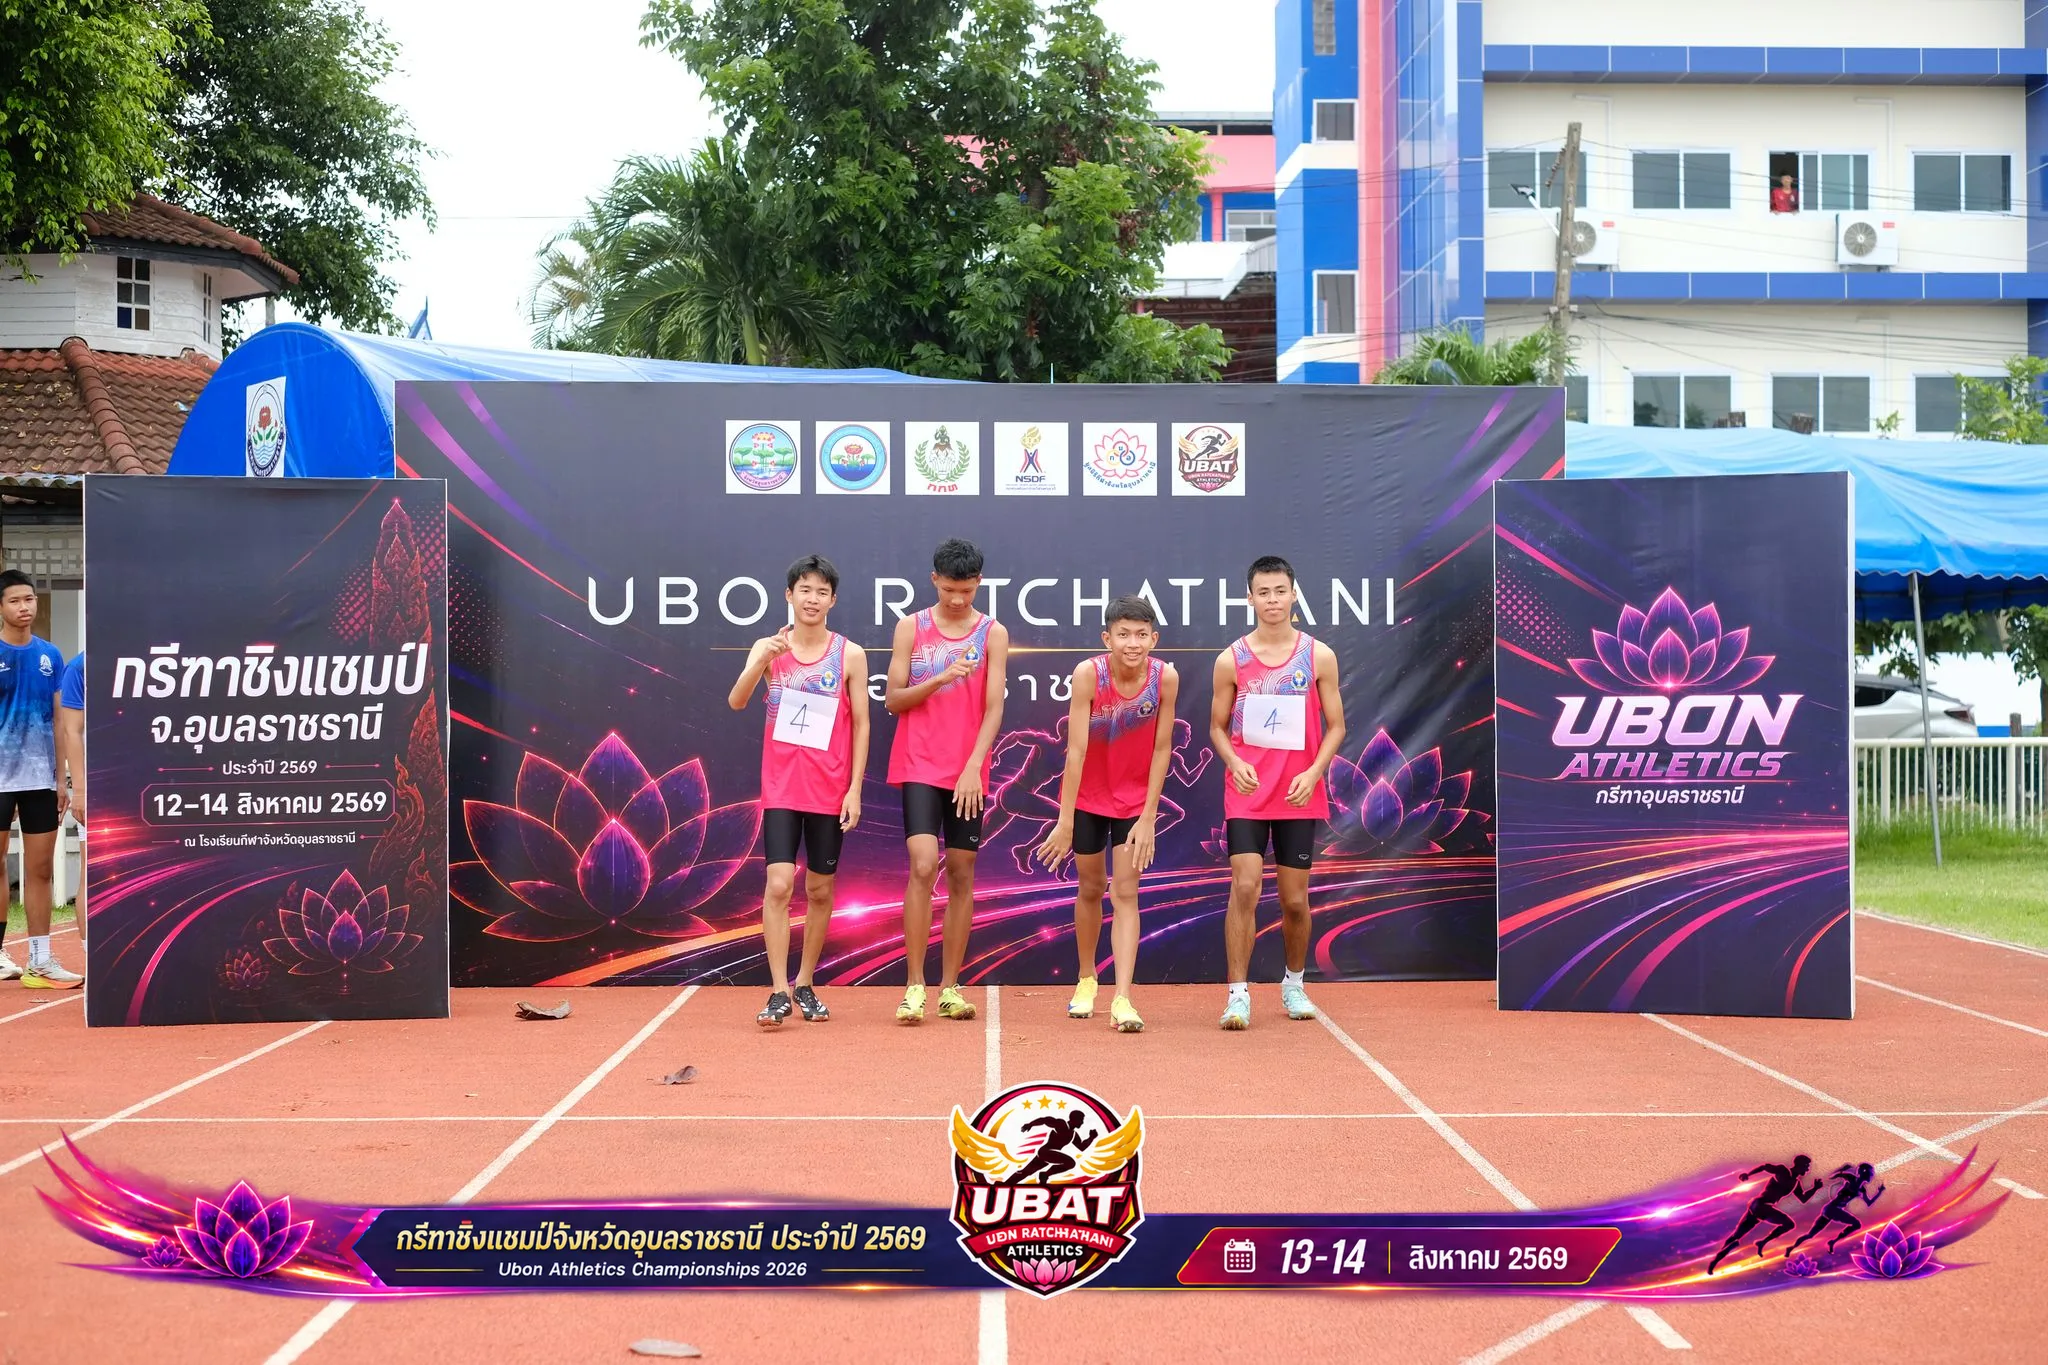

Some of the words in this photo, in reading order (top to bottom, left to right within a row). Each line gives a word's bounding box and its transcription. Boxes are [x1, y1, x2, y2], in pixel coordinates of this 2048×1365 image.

[1015, 475, 1046, 483] NSDF
[1184, 460, 1233, 473] UBAT
[927, 483, 958, 493] กกท
[588, 576, 827, 626] UBO
[874, 577, 1394, 626] RTCHATHANI
[112, 642, 428, 698] กรีฑาชิงแชมป์
[151, 702, 384, 754] จ.อุบลราชธานี
[790, 703, 810, 734] 4
[1263, 708, 1282, 734] 4
[1551, 694, 1804, 746] UBON
[222, 759, 275, 775] ประจำปี
[280, 760, 317, 774] 2569
[1556, 751, 1796, 779] ATHLETICS
[237, 792, 322, 815] สิงหาคม
[330, 791, 387, 813] 2569
[1595, 785, 1746, 809] กรีฑาอุบลราชธานี
[184, 837, 196, 847] ณ
[199, 832, 356, 848] โรงเรียนกีฬาจังหวัดอุบลราชธานี
